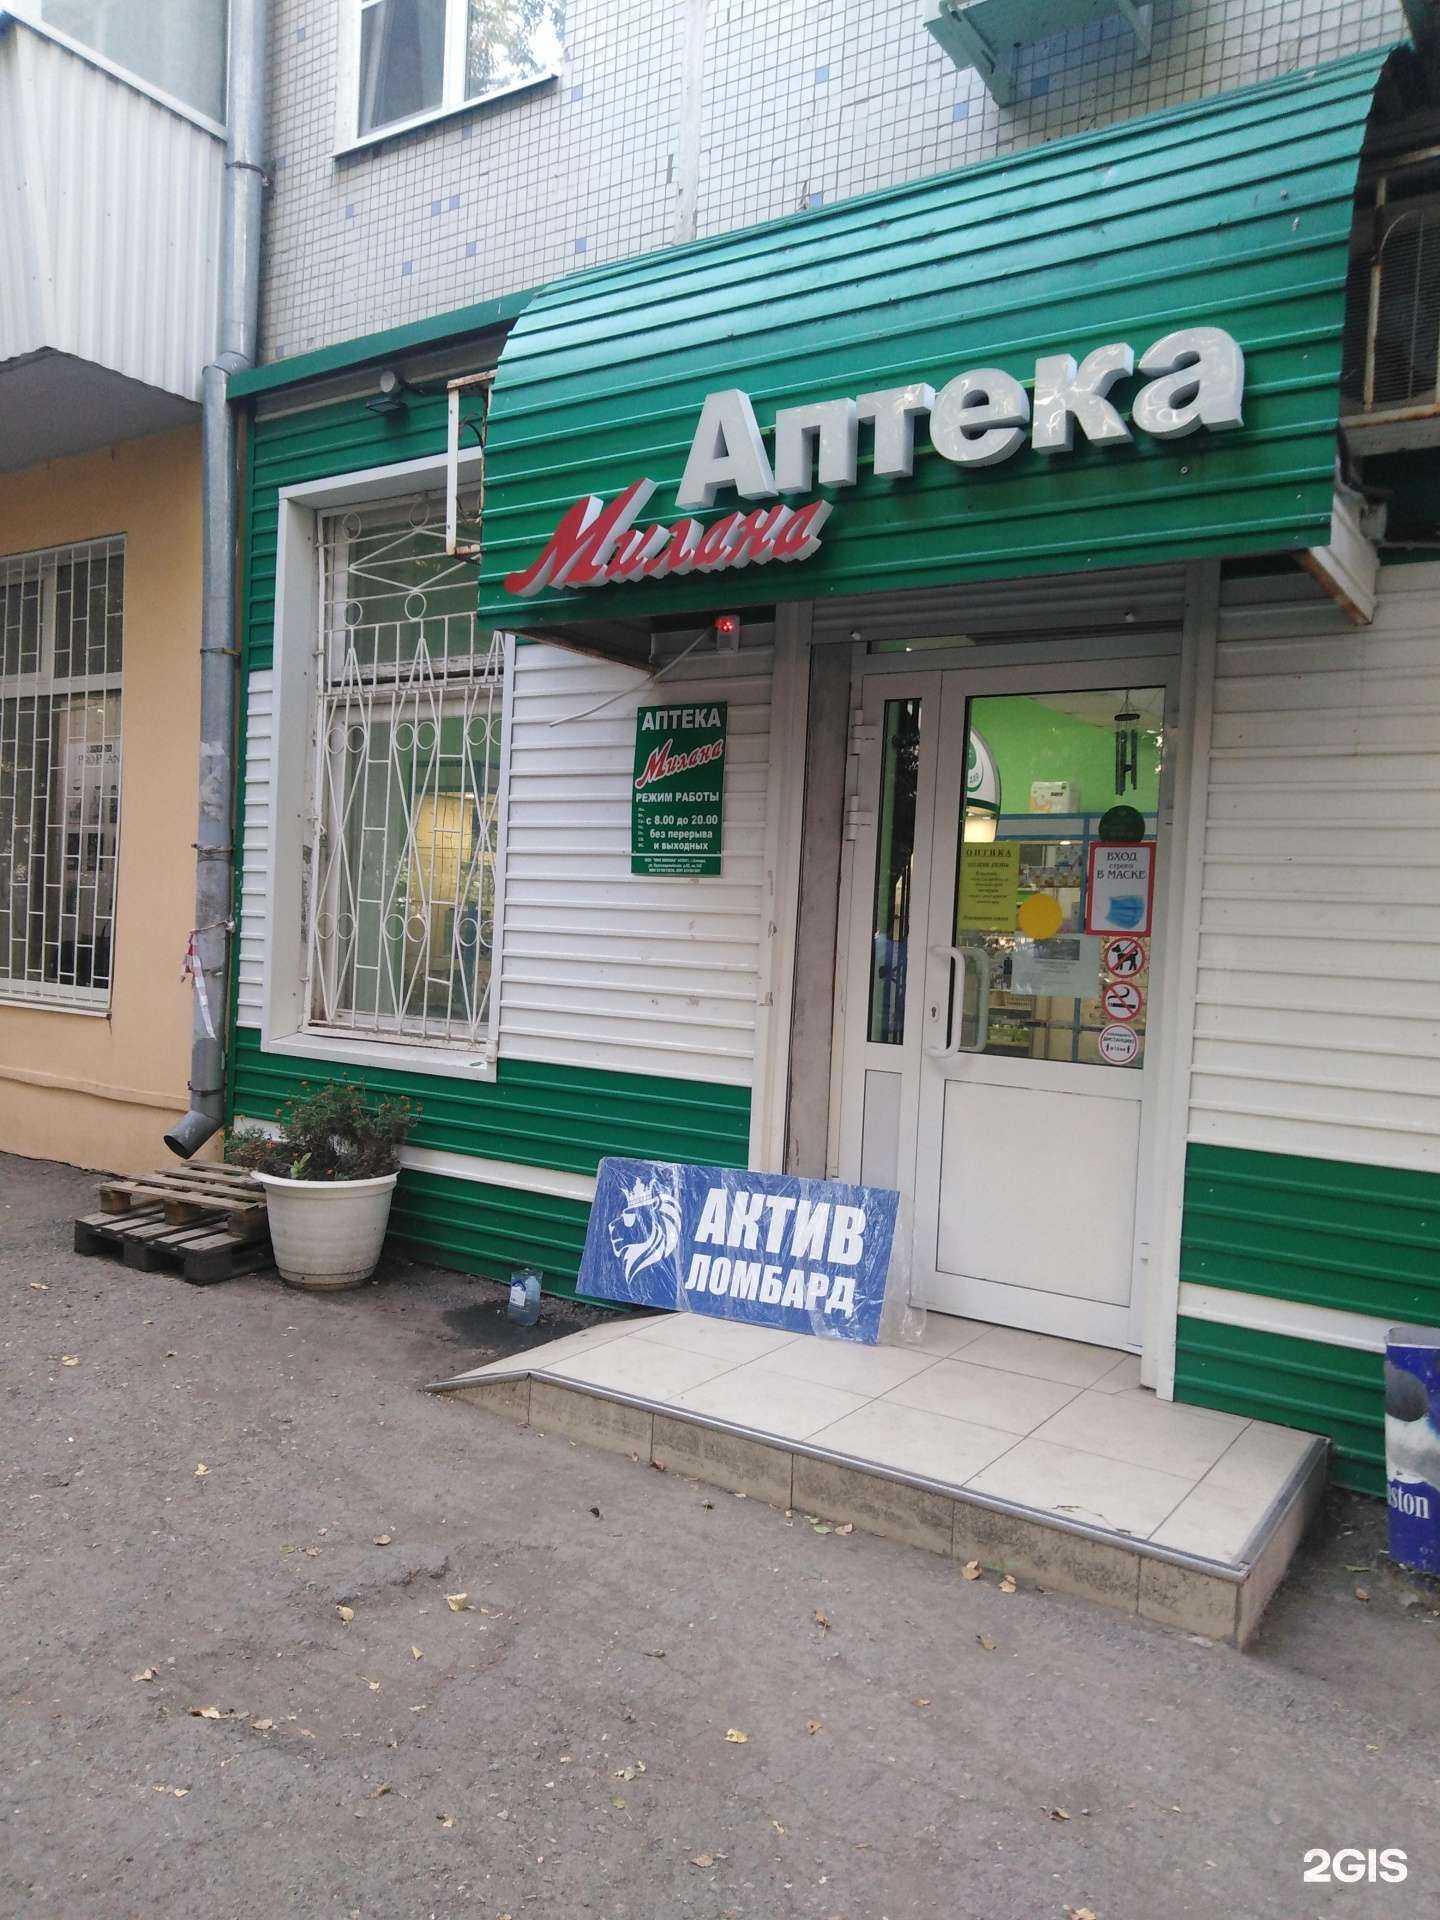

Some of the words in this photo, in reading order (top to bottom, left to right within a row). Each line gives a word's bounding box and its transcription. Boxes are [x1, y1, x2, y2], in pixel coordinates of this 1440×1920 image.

[675, 326, 1244, 509] Аптека
[504, 478, 833, 597] Милана
[641, 708, 721, 731] АПТЕКА
[635, 738, 724, 789] Милана
[636, 793, 672, 802] РЕЖИМ
[676, 792, 719, 801] РАБОТЫ
[654, 815, 674, 824] 8.00
[677, 817, 689, 826] до
[691, 815, 718, 824] 20.00
[650, 829, 665, 838] без
[668, 830, 713, 840] перерыва
[662, 843, 708, 851] выходных
[1107, 852, 1137, 861] ВХОД
[1097, 871, 1104, 880] В
[1107, 871, 1146, 880] МАСКЕ
[694, 1188, 867, 1265] АКТИВ
[685, 1253, 857, 1318] ЛОМБАРД
